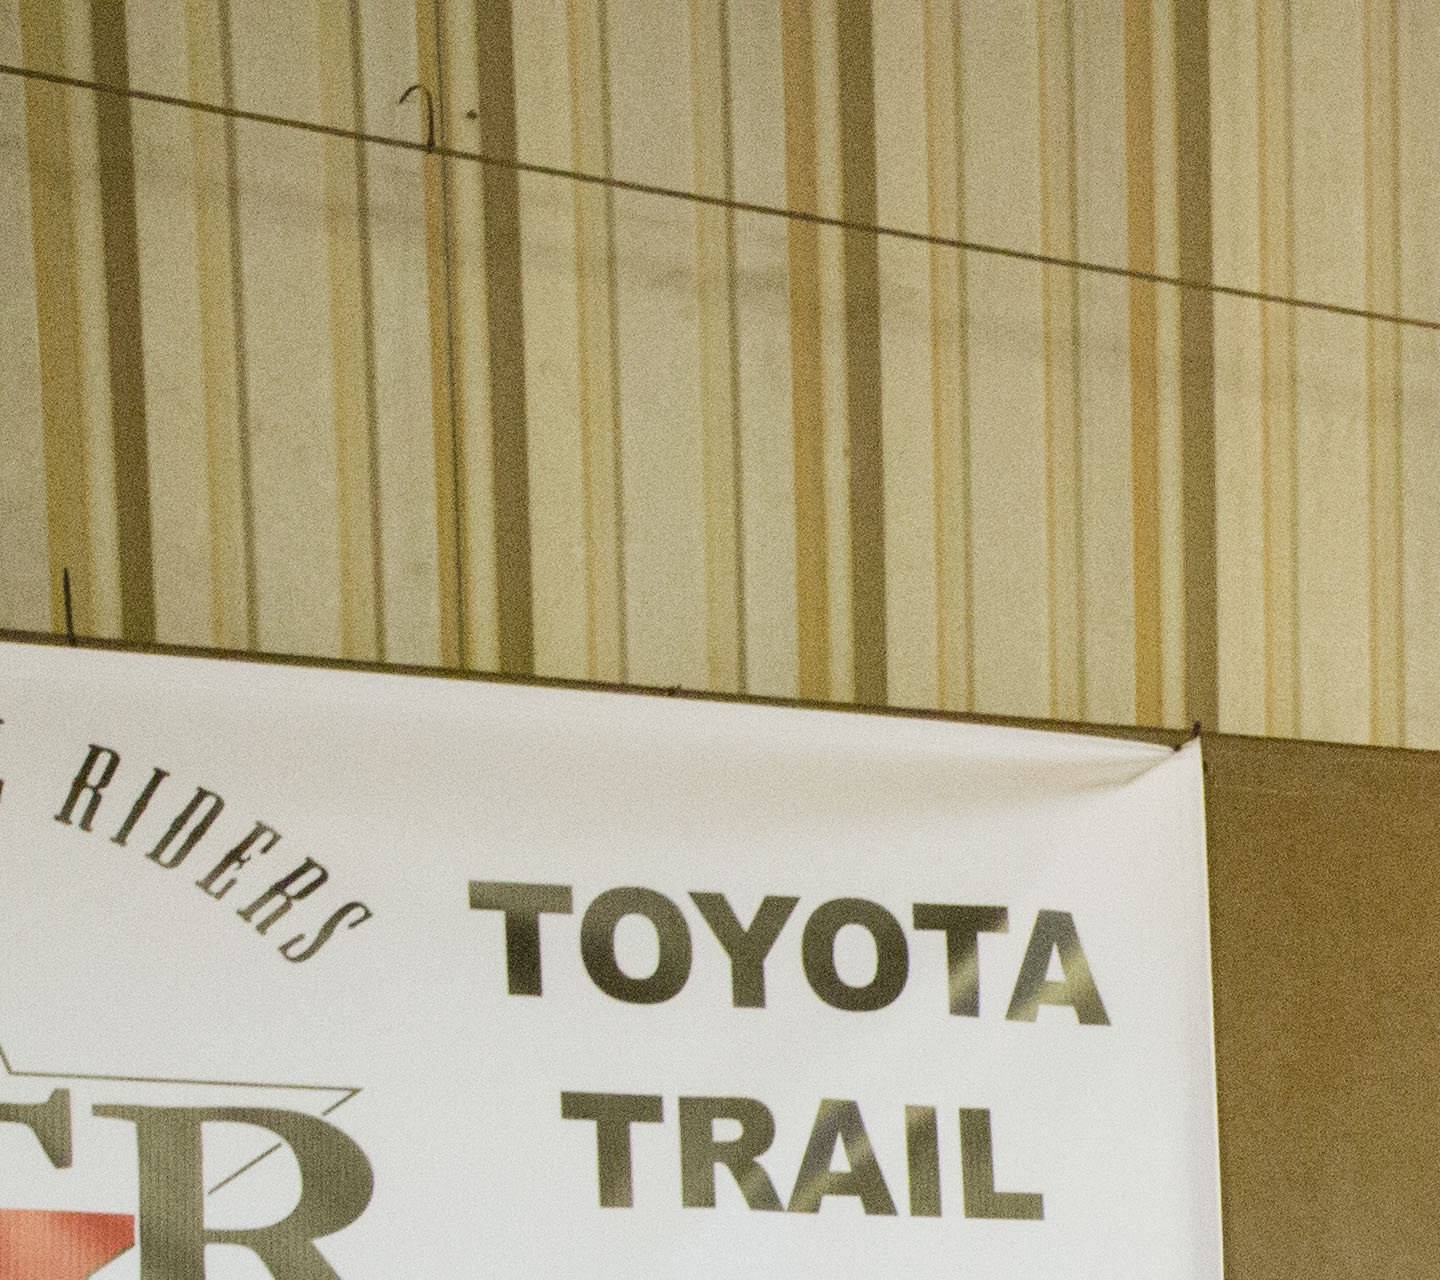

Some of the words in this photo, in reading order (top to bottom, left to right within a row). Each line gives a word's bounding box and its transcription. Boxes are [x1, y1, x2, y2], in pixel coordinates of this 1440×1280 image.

[53, 743, 374, 963] RIDERS
[468, 880, 1112, 1025] TOYOTA
[561, 1091, 1045, 1220] TRAIL
